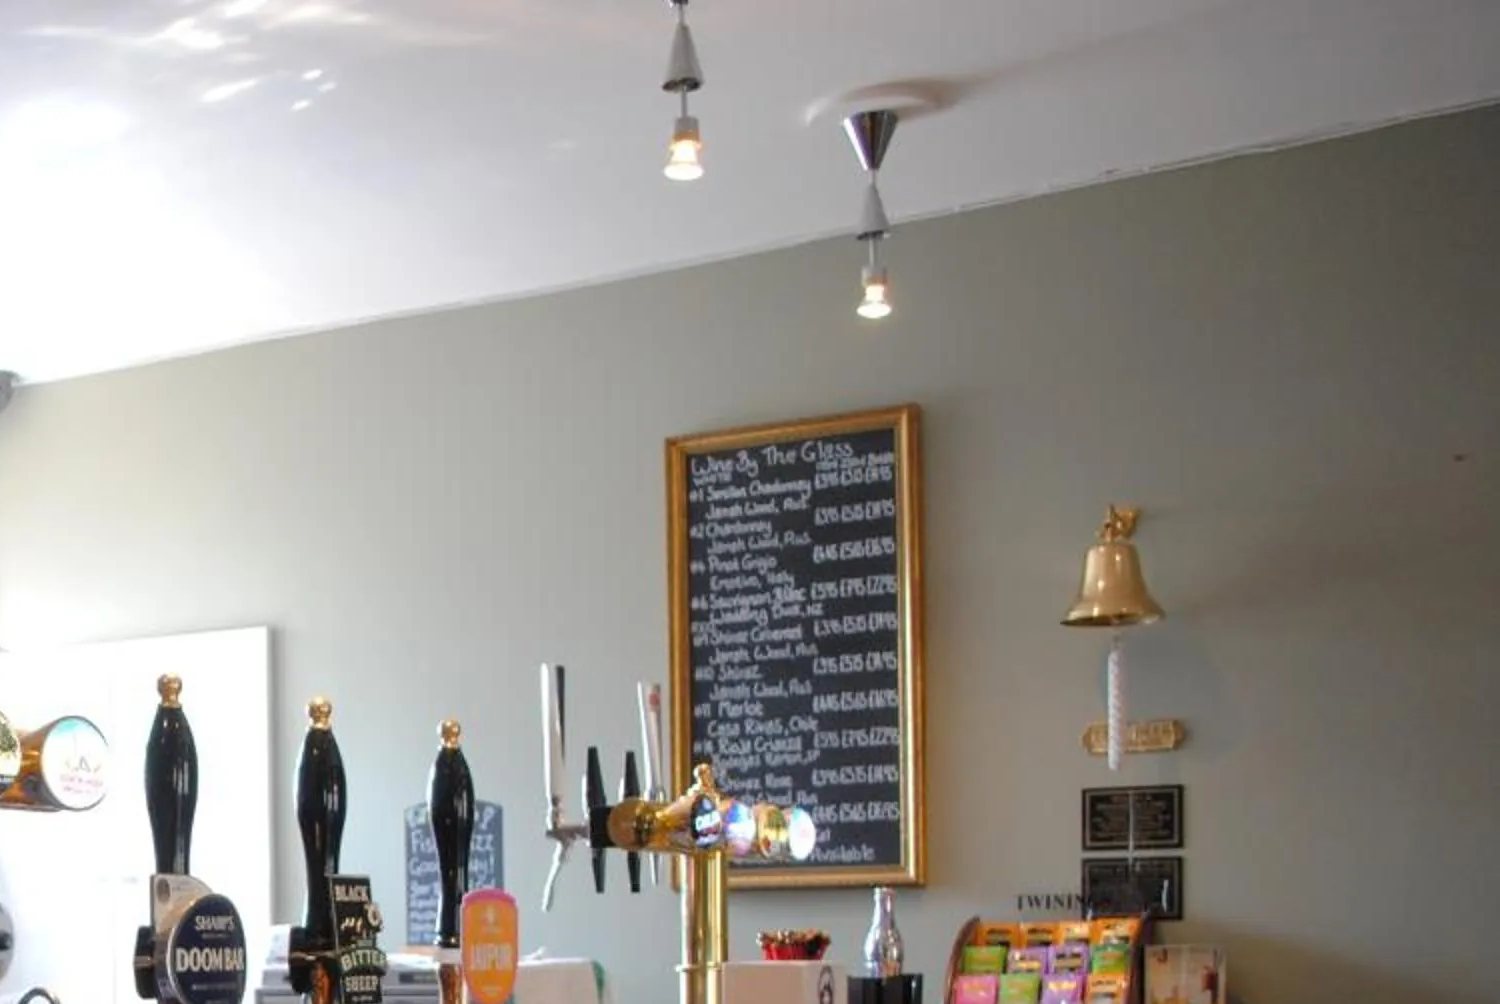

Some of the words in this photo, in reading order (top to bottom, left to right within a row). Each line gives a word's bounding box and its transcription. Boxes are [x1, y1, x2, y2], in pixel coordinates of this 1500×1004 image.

[736, 449, 759, 478] By
[761, 445, 797, 466] The
[801, 440, 854, 463] Glass
[334, 884, 368, 902] BLACK
[175, 947, 224, 972] DOOM
[224, 947, 245, 971] BAR
[345, 975, 379, 992] SHEEP
